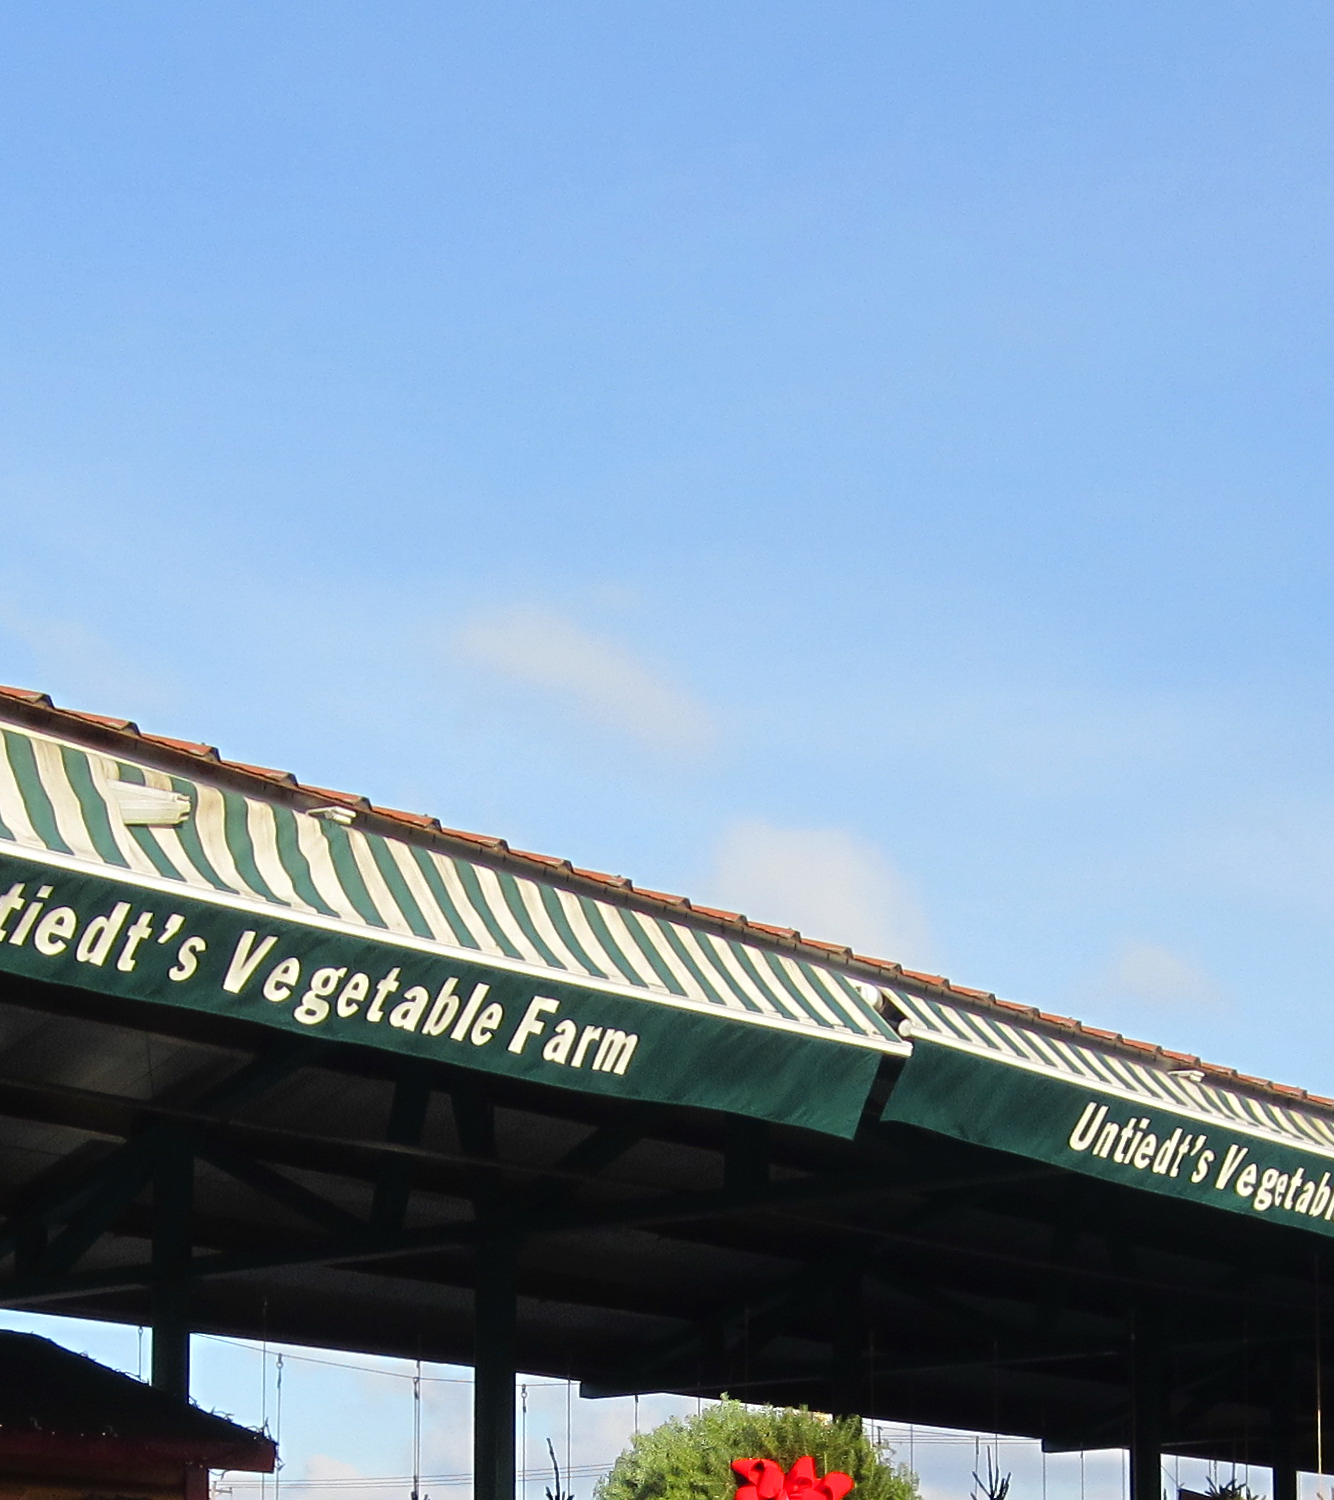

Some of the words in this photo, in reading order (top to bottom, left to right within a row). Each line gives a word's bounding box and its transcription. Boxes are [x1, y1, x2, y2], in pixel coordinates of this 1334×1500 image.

[222, 930, 504, 1045] Vegetable
[507, 995, 640, 1076] Farm
[1069, 1101, 1215, 1184] Untiedt's
